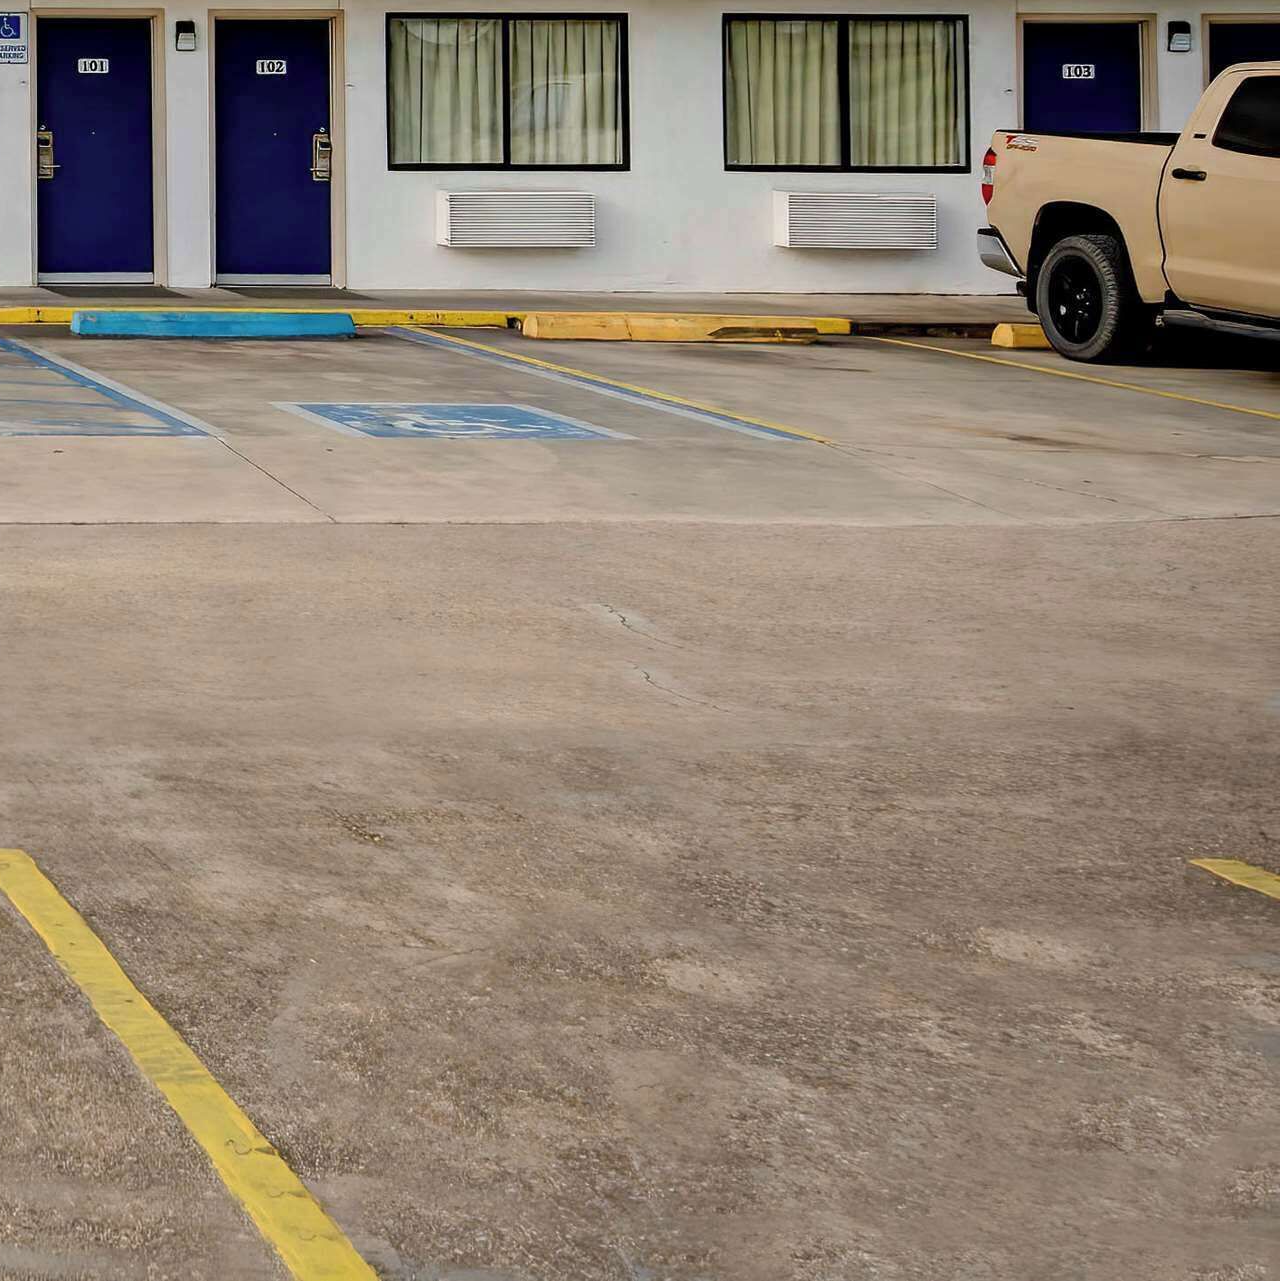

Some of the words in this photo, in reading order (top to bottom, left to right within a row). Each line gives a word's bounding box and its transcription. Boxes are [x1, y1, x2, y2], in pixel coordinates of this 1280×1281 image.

[81, 60, 106, 72] 101
[258, 61, 285, 73] 102
[1066, 66, 1092, 77] 103
